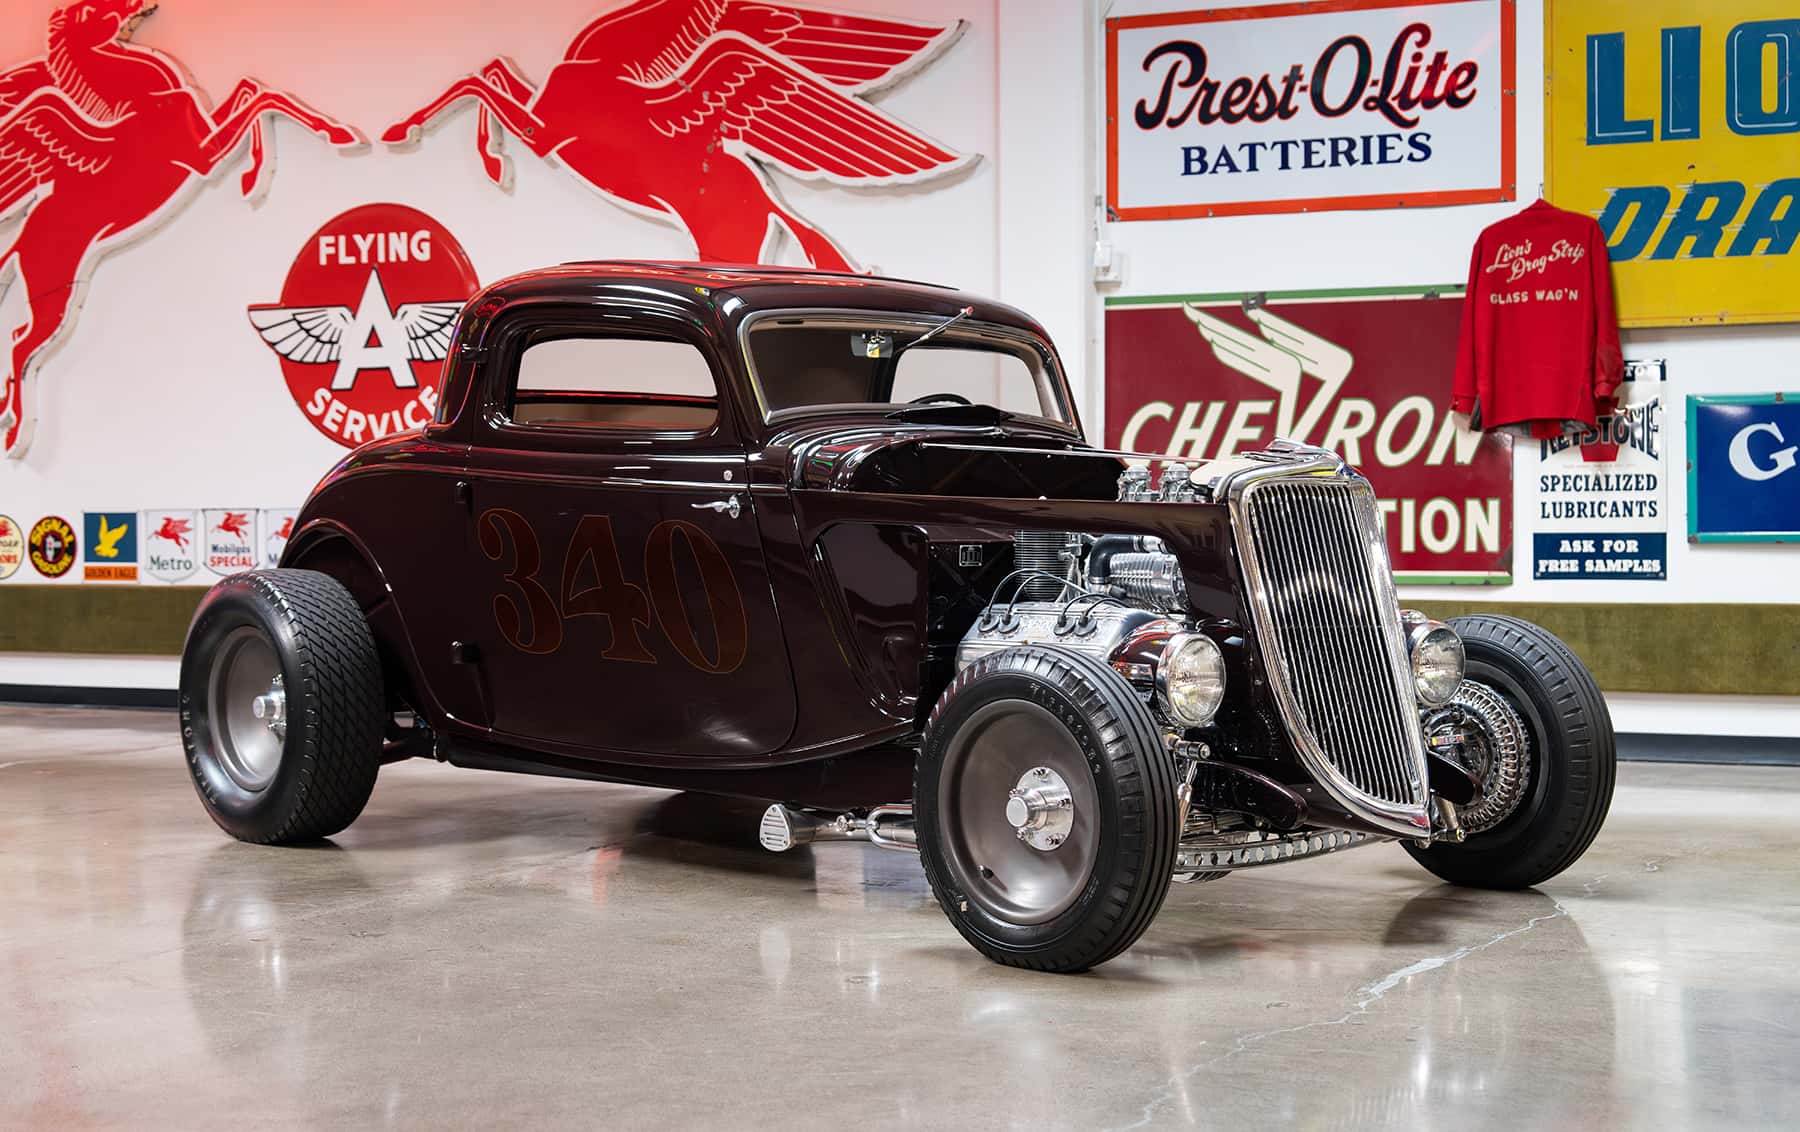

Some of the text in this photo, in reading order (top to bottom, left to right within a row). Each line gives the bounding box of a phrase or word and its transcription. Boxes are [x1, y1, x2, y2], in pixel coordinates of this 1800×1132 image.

[1134, 22, 1479, 130] Prest-O-Lite
[1181, 132, 1432, 176] BATTERIES
[318, 230, 431, 266] FLYING
[1486, 239, 1532, 273] Lion's
[1506, 239, 1585, 284] Drag Strip
[1489, 287, 1579, 305] GLASS WAG'N
[331, 263, 419, 391] A
[1119, 378, 1485, 467] CHEVRON
[1728, 421, 1798, 481] G
[1540, 473, 1658, 493] SPECIALIZED
[1540, 500, 1658, 519] LUBRICANTS
[150, 555, 193, 571] Metro
[209, 555, 252, 567] SPECIAL
[1560, 539, 1639, 553] ASK FOR
[1538, 559, 1661, 573] FREE SAMPLES
[478, 508, 747, 674] 340
